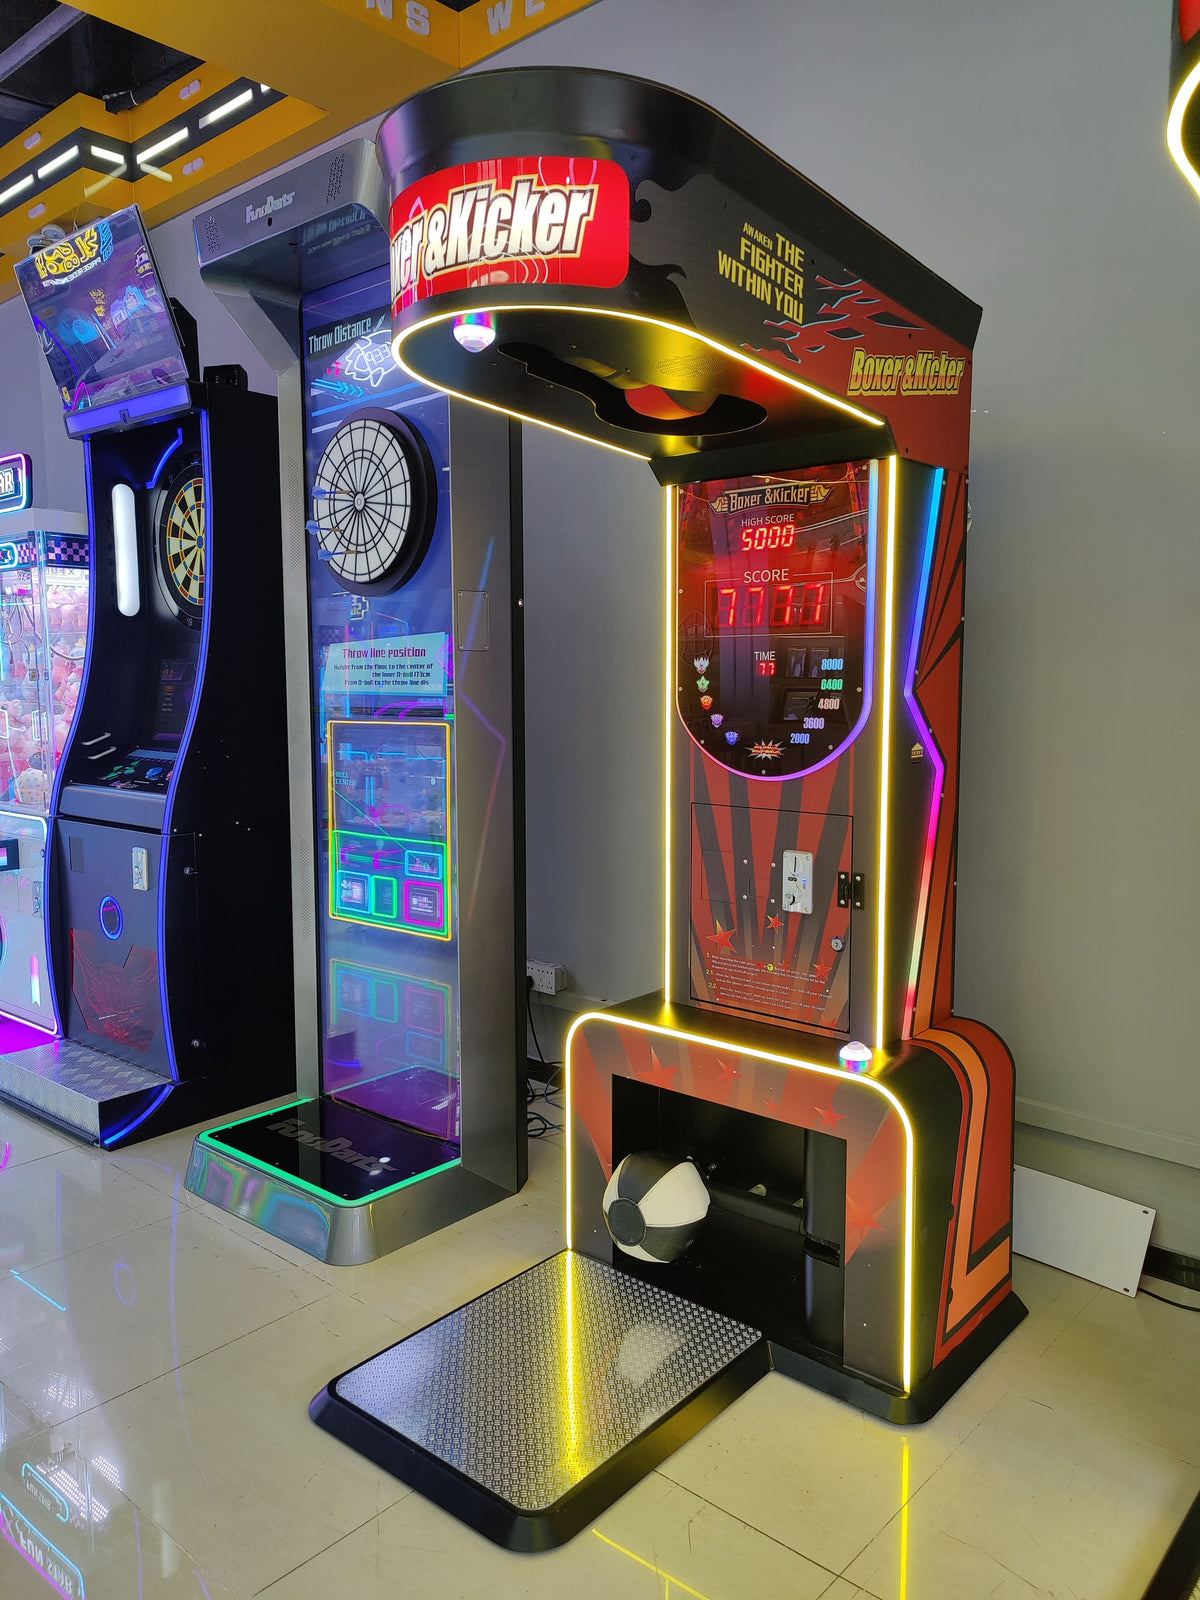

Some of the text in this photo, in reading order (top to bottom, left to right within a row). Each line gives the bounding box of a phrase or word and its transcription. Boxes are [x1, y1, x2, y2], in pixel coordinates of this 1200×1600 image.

[743, 222, 805, 273] AWAKEN THE
[740, 237, 804, 299] FIGHTER
[718, 250, 804, 325] WITHIN YOU
[309, 317, 372, 354] Throw Distance
[847, 346, 901, 397] Boxer
[730, 492, 762, 512] Boxer
[741, 514, 795, 527] HIGH SCORE
[742, 525, 795, 551] 5000
[743, 568, 790, 584] SCORE
[719, 583, 825, 627] 7777
[342, 646, 426, 659] Throw line position
[754, 651, 776, 661] TIME
[759, 662, 776, 676] 77
[821, 658, 844, 671] 8000
[820, 678, 843, 690] 6400
[817, 698, 840, 710] 4800
[803, 717, 825, 729] 3600
[790, 733, 810, 744] 2000
